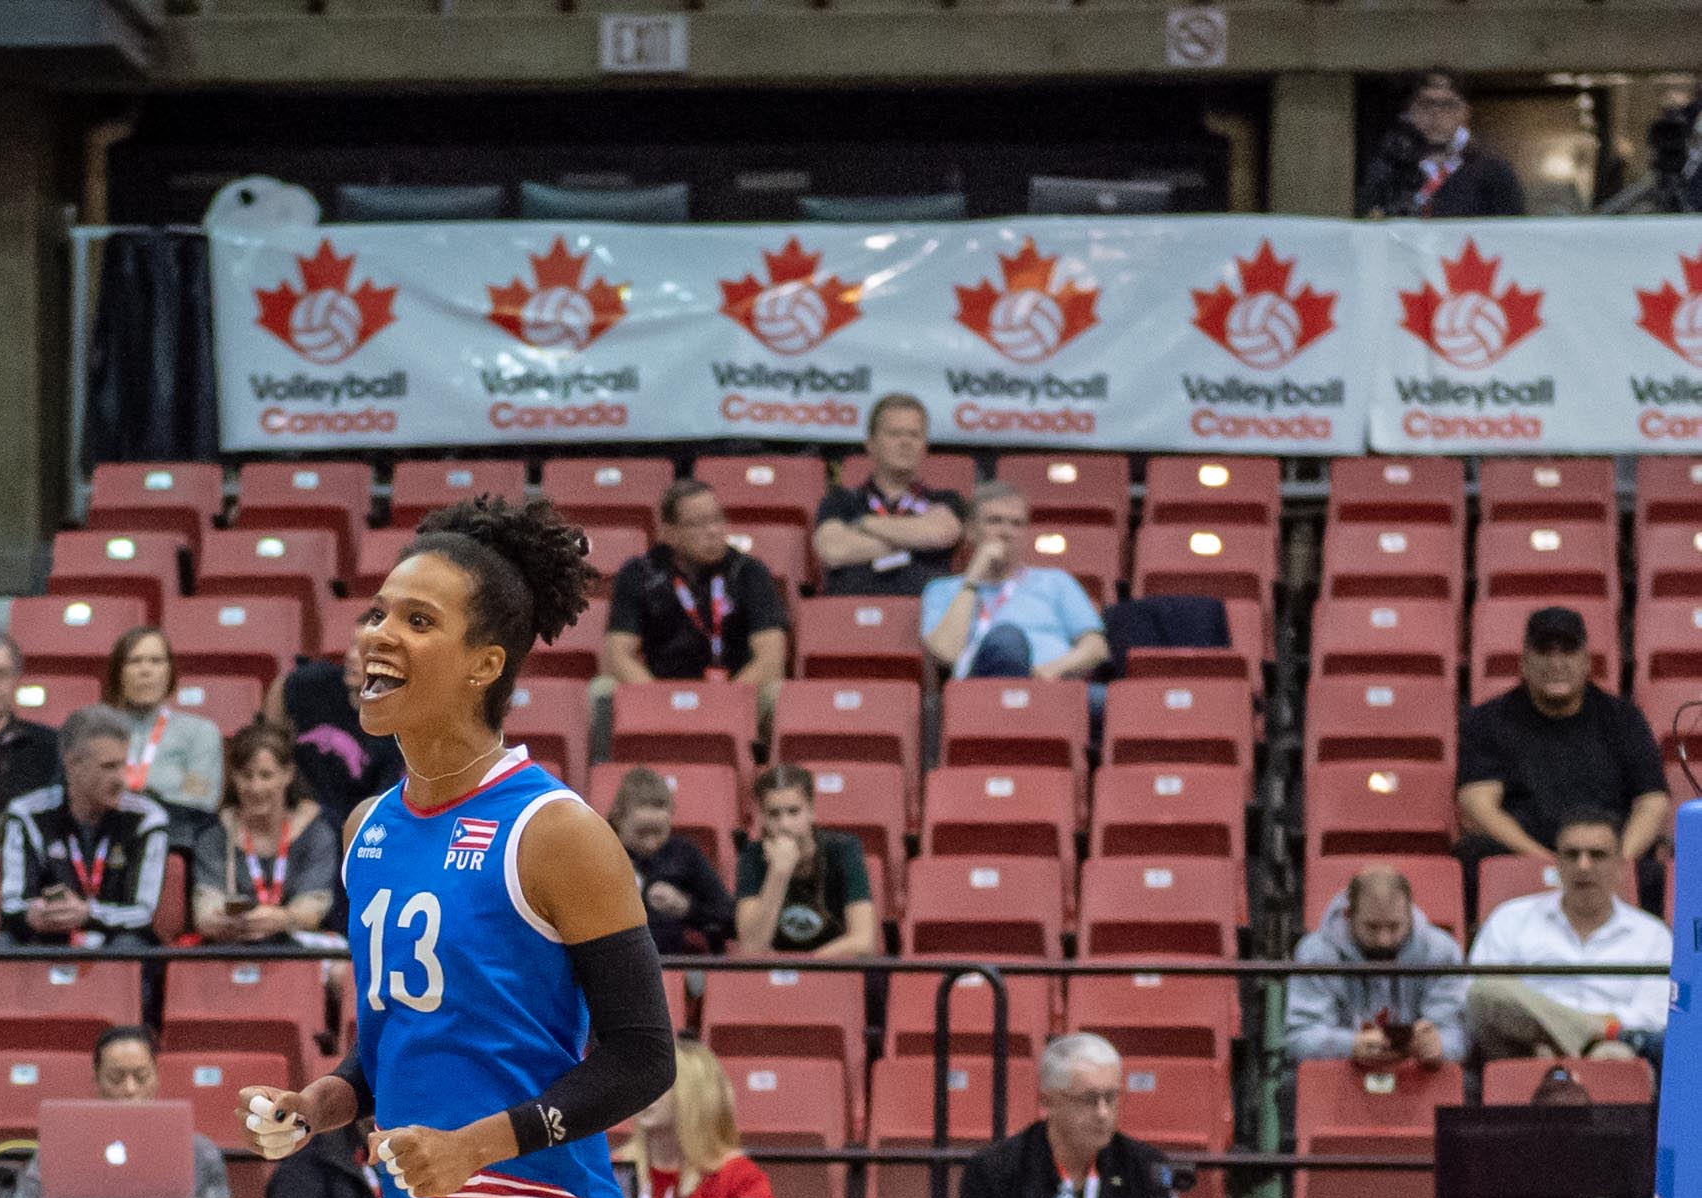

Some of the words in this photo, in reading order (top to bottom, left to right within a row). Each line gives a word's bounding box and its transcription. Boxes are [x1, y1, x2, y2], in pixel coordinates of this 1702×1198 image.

[249, 371, 407, 405] Volleyball
[711, 361, 871, 396] Volleyball
[945, 368, 1108, 405] Volleyball
[1181, 373, 1345, 411] Volleyball
[1395, 375, 1555, 409] Volleyball
[260, 406, 396, 435] Canada
[489, 401, 628, 430] Canada
[720, 394, 859, 426] Canada
[954, 402, 1096, 433] Canada
[1191, 409, 1332, 440] Canada
[1402, 410, 1542, 440] Canada
[357, 847, 383, 860] errea
[443, 851, 485, 871] PUR
[361, 888, 444, 1013] 13
